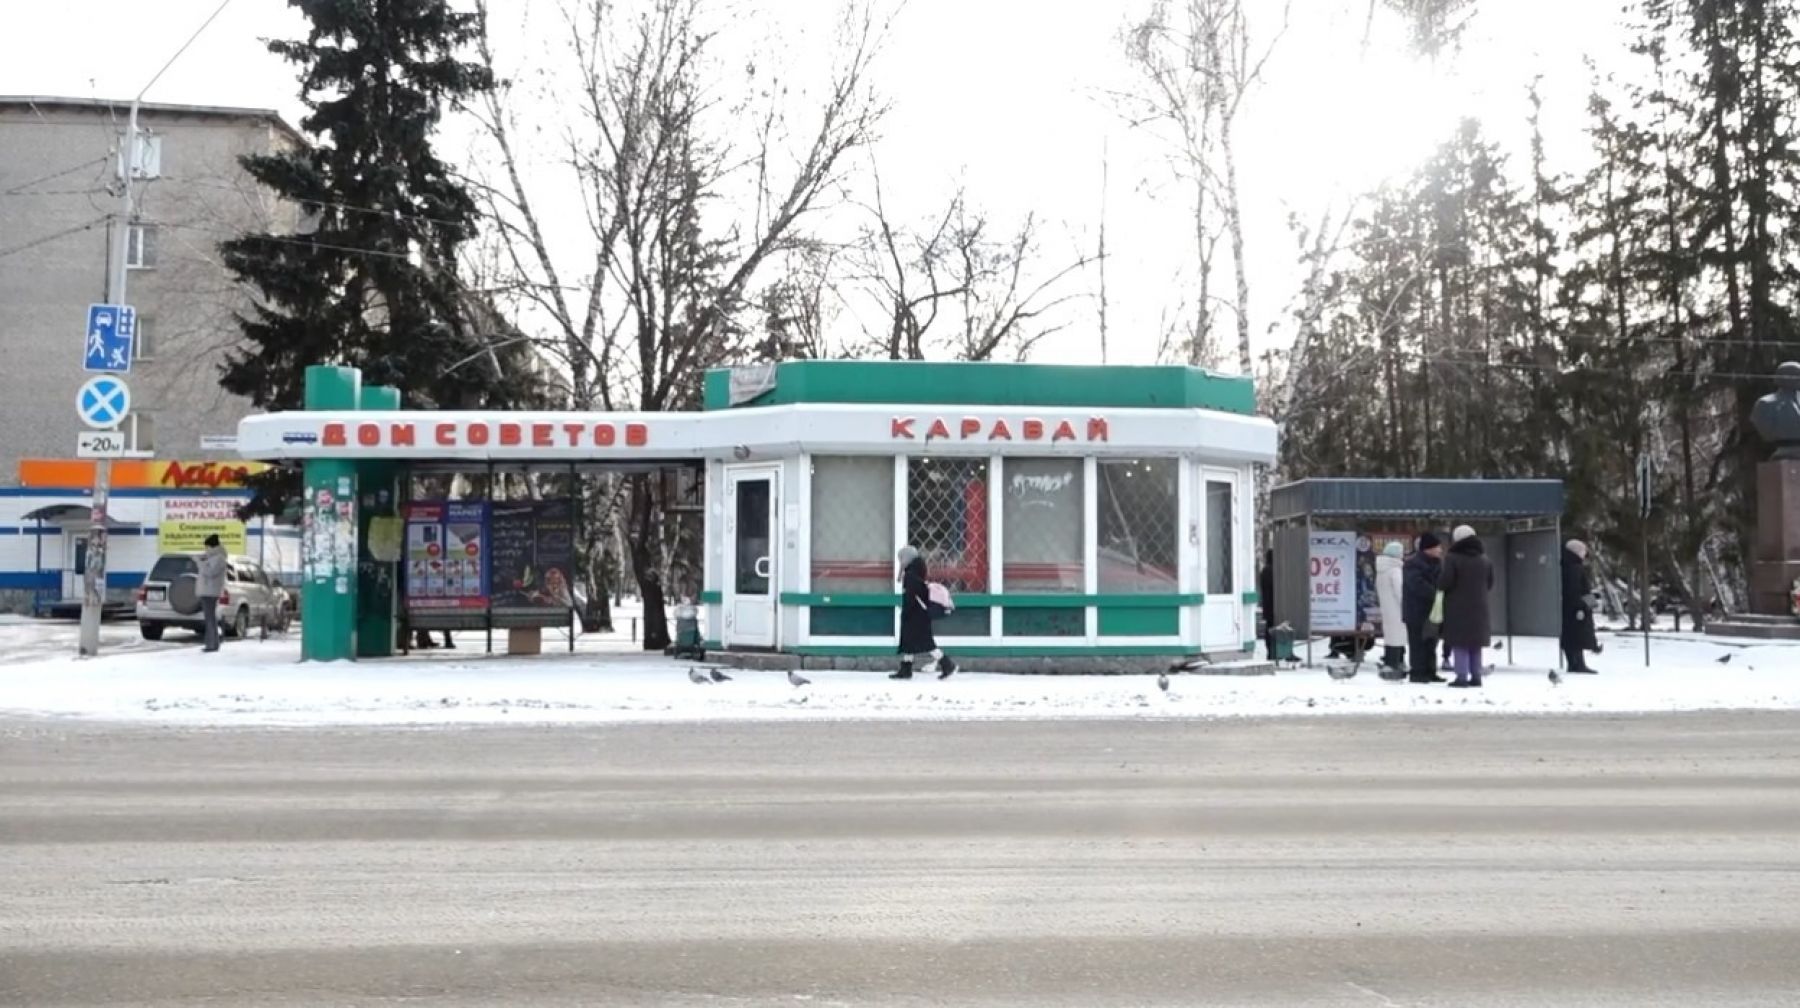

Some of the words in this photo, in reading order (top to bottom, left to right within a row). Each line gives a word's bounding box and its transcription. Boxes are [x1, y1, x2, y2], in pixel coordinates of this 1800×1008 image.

[322, 423, 415, 446] ДОМ
[435, 423, 648, 446] СОВЕТОВ
[891, 416, 1108, 442] КАРАВАЙ
[1316, 581, 1340, 595] ВСЁ
